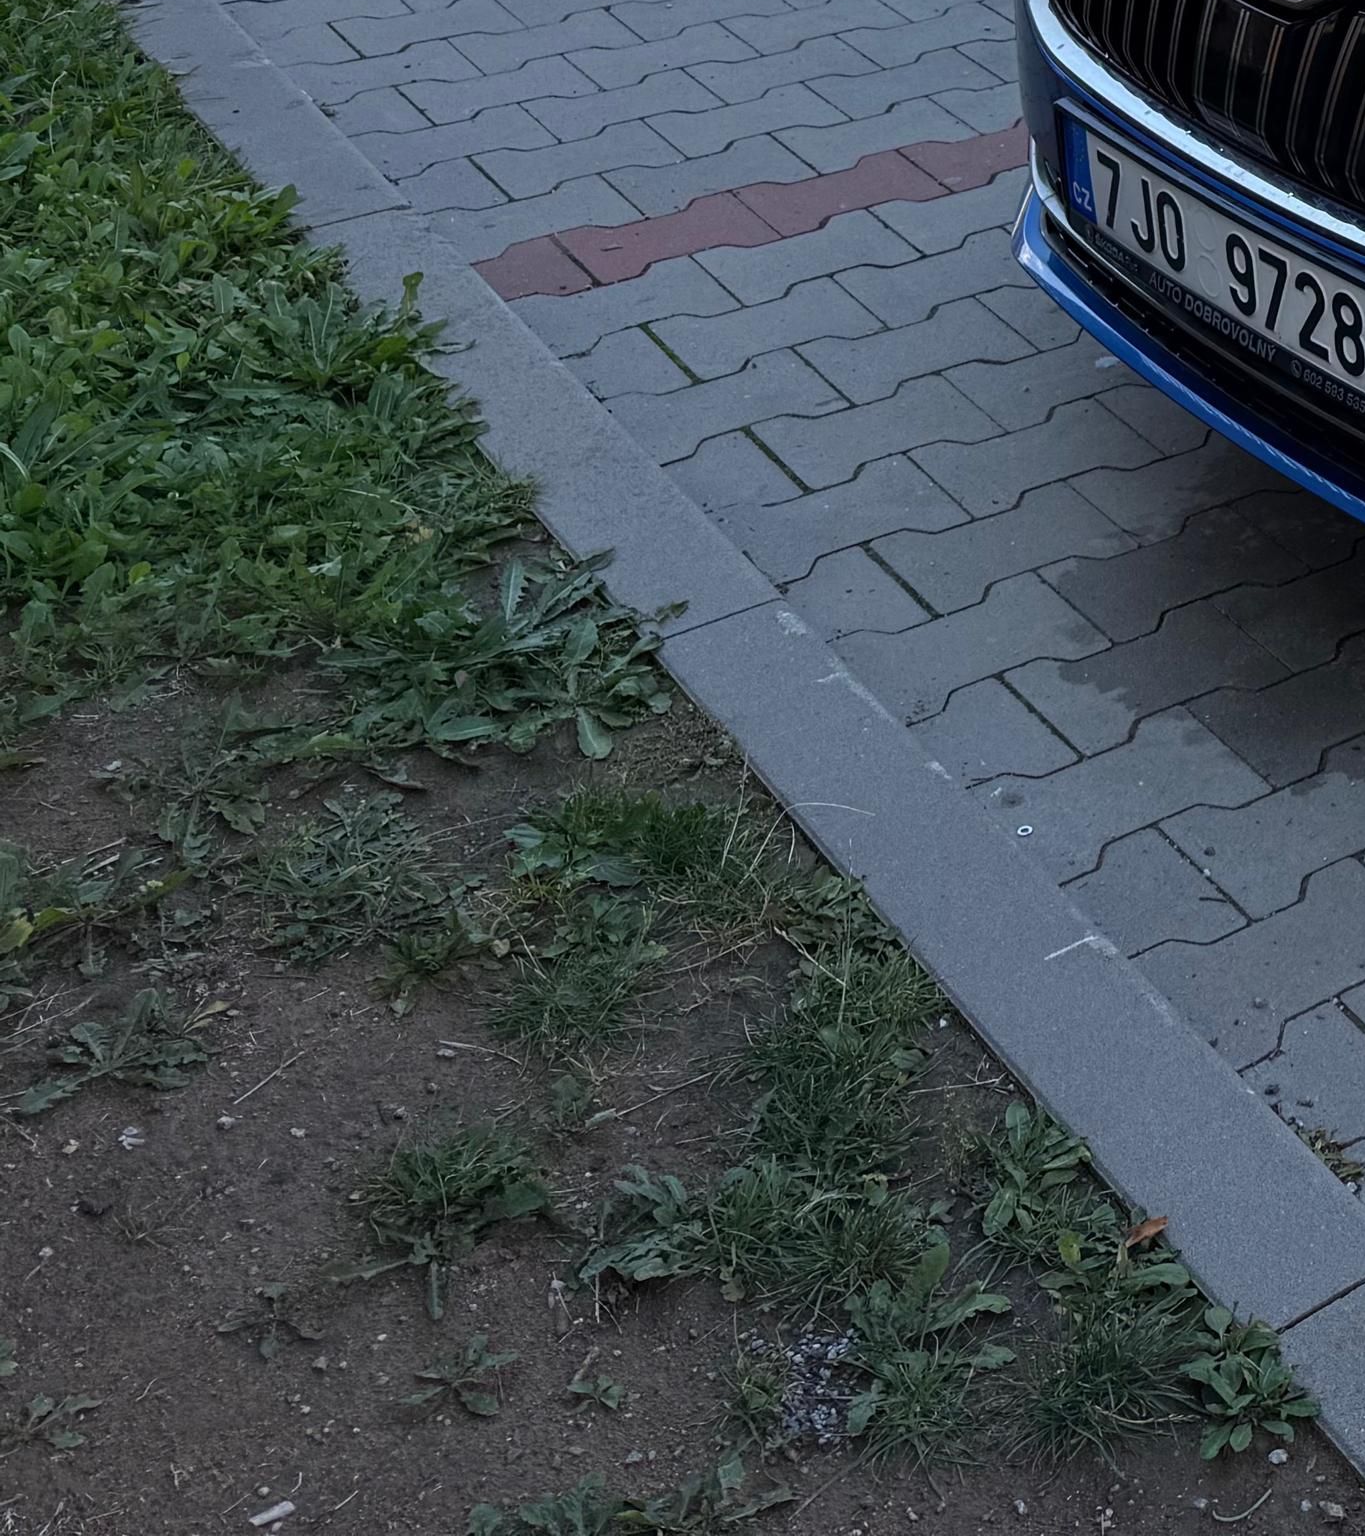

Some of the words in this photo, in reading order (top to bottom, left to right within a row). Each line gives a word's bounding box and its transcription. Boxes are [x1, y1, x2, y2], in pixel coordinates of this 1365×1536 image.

[1072, 181, 1093, 213] CZ
[1097, 147, 1187, 273] 7J0
[1225, 233, 1365, 378] 9728
[1148, 271, 1182, 305] AUTO
[1184, 293, 1277, 363] DOBROVOLNÝ
[1303, 368, 1324, 390] 602
